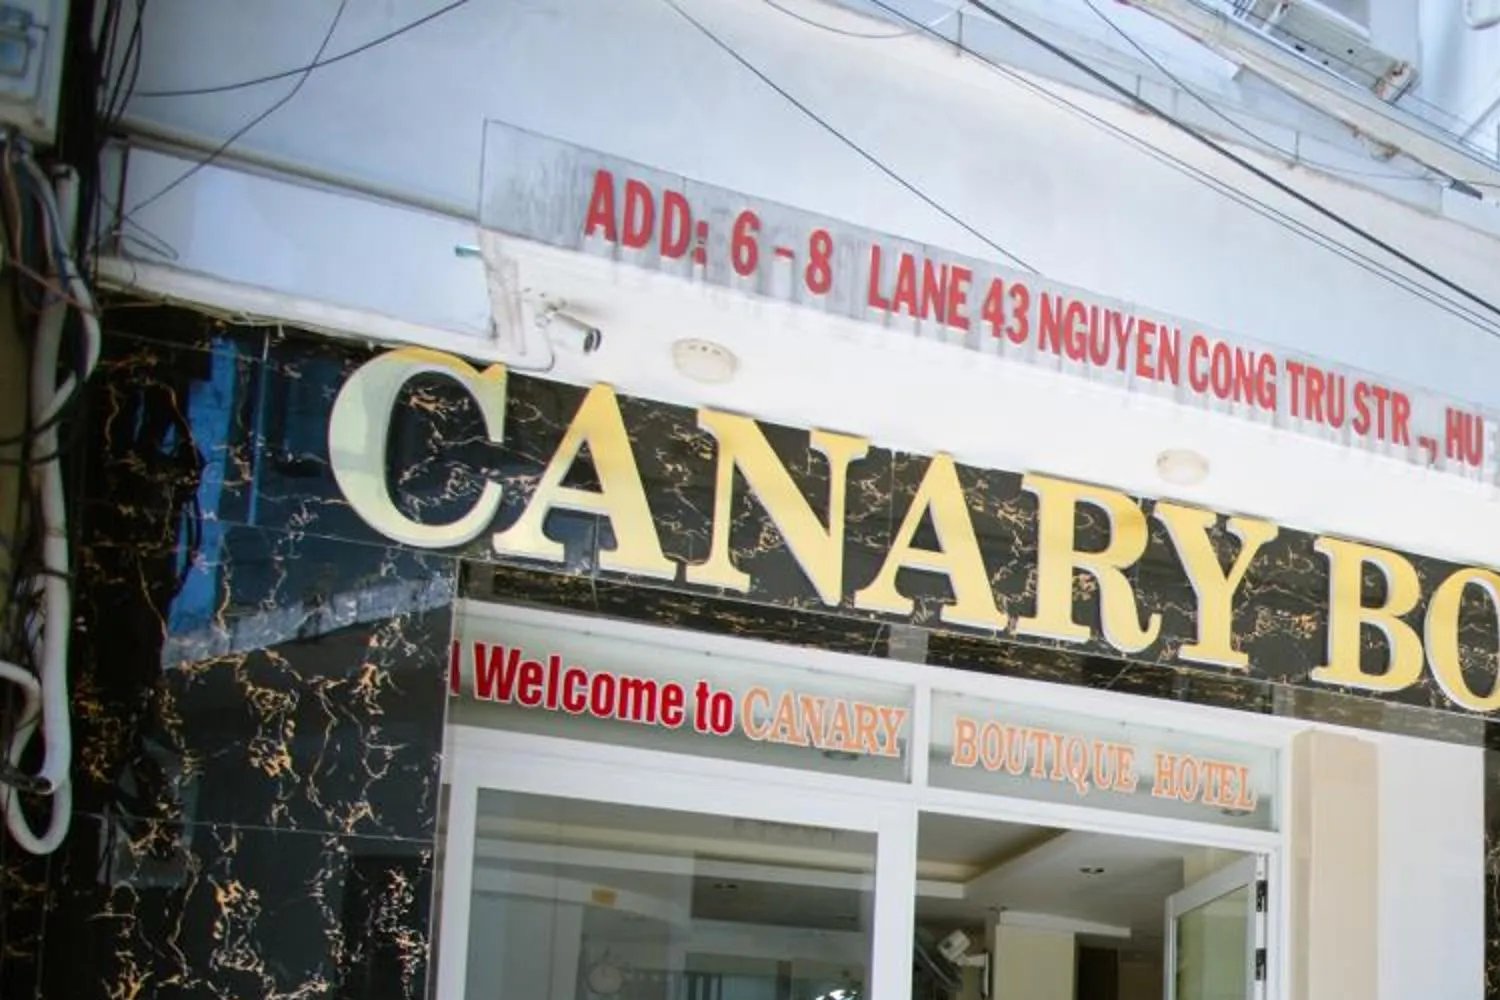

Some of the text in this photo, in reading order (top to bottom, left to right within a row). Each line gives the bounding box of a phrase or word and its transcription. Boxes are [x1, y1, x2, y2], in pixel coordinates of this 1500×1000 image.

[585, 168, 709, 265] ADD:
[867, 243, 972, 332] LANE
[980, 277, 1030, 346] 43
[1037, 292, 1182, 386] NGUYEN
[1187, 333, 1278, 413] CONG
[1285, 360, 1347, 430] TRU
[327, 344, 1278, 671] CANARY
[472, 640, 1258, 812] Welcome to CANARY BOUTIQUE HOTEL
